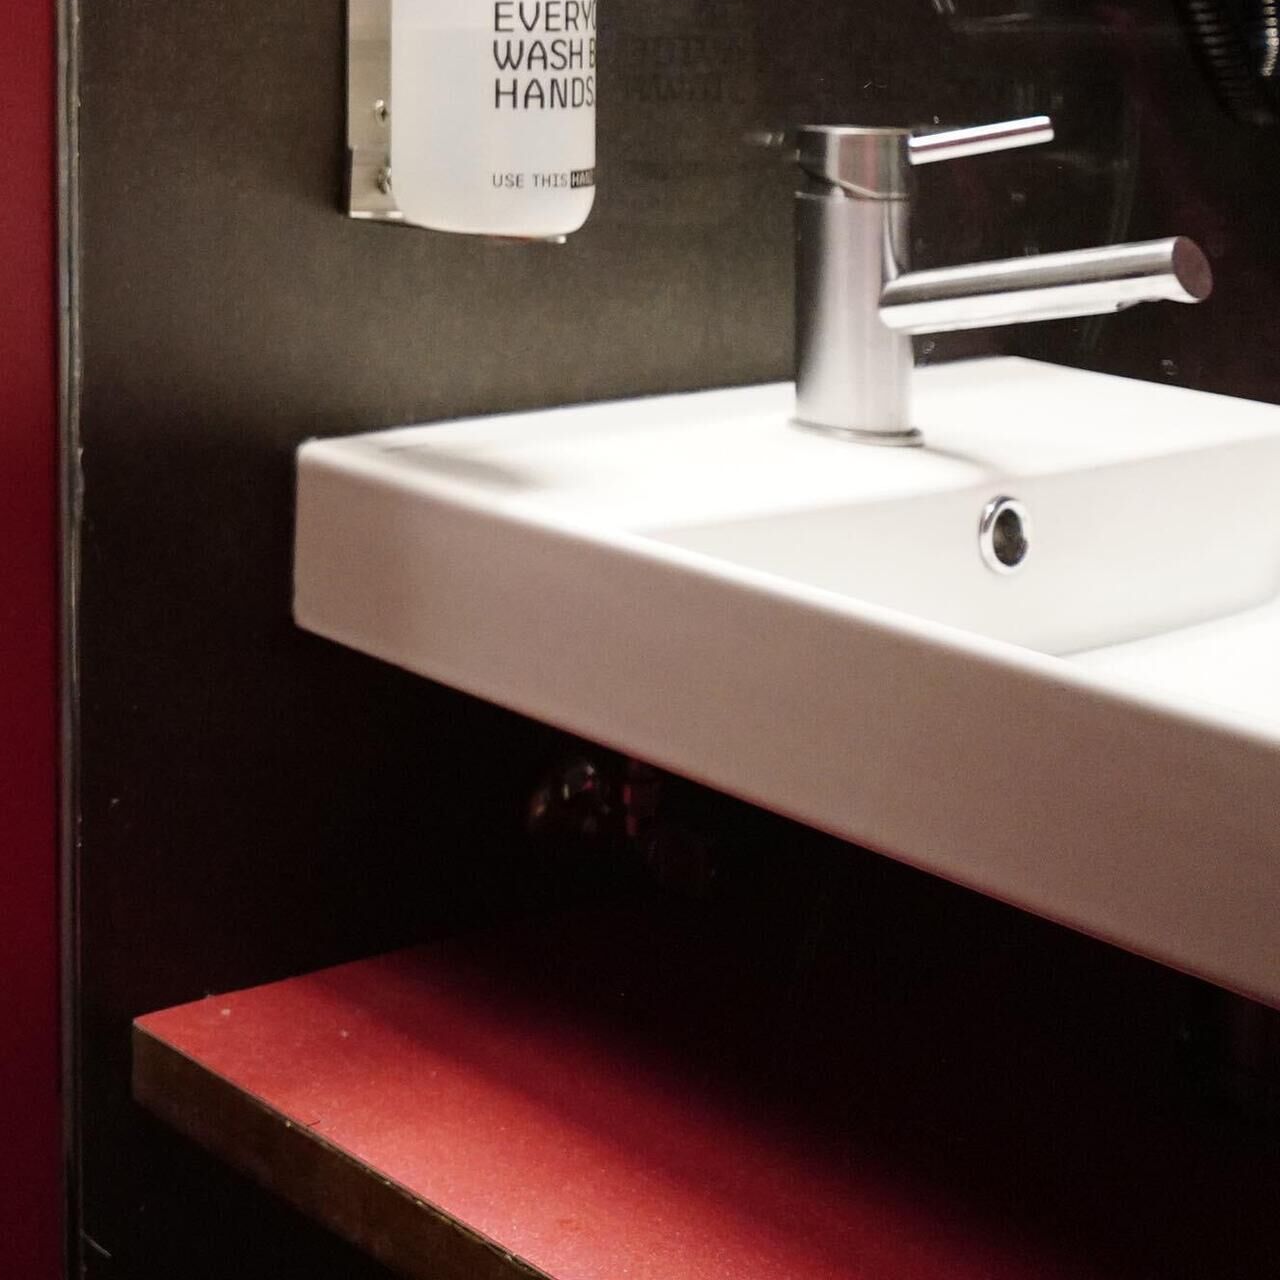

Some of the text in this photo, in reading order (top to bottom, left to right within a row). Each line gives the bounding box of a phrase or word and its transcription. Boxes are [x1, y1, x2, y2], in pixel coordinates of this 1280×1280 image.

[493, 38, 583, 70] WASH
[492, 173, 524, 189] USE
[531, 173, 568, 188] THIS
